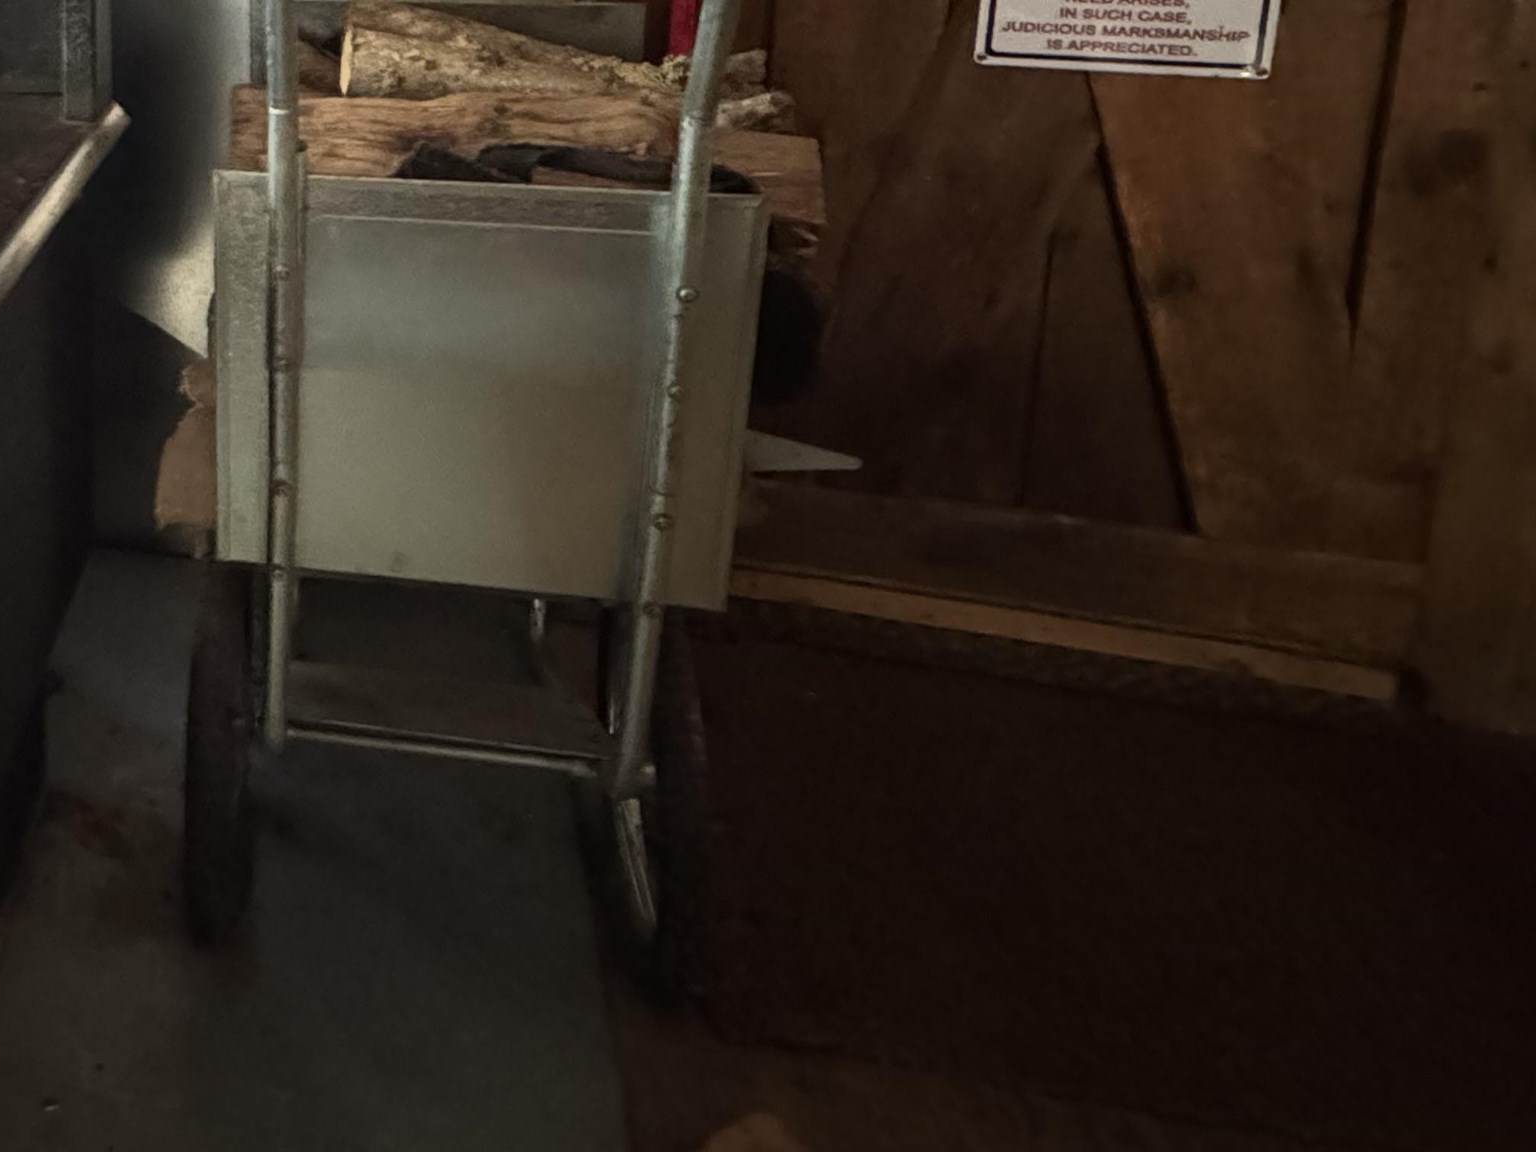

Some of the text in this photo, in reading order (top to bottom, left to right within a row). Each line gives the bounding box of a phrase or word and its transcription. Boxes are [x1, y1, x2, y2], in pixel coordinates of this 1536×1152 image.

[1059, 8, 1077, 19] IN
[1083, 9, 1132, 21] SUCH
[1002, 21, 1250, 42] JUDICIOUS MARKSMANSHIP
[1047, 39, 1198, 56] IS APPRECIATED.
